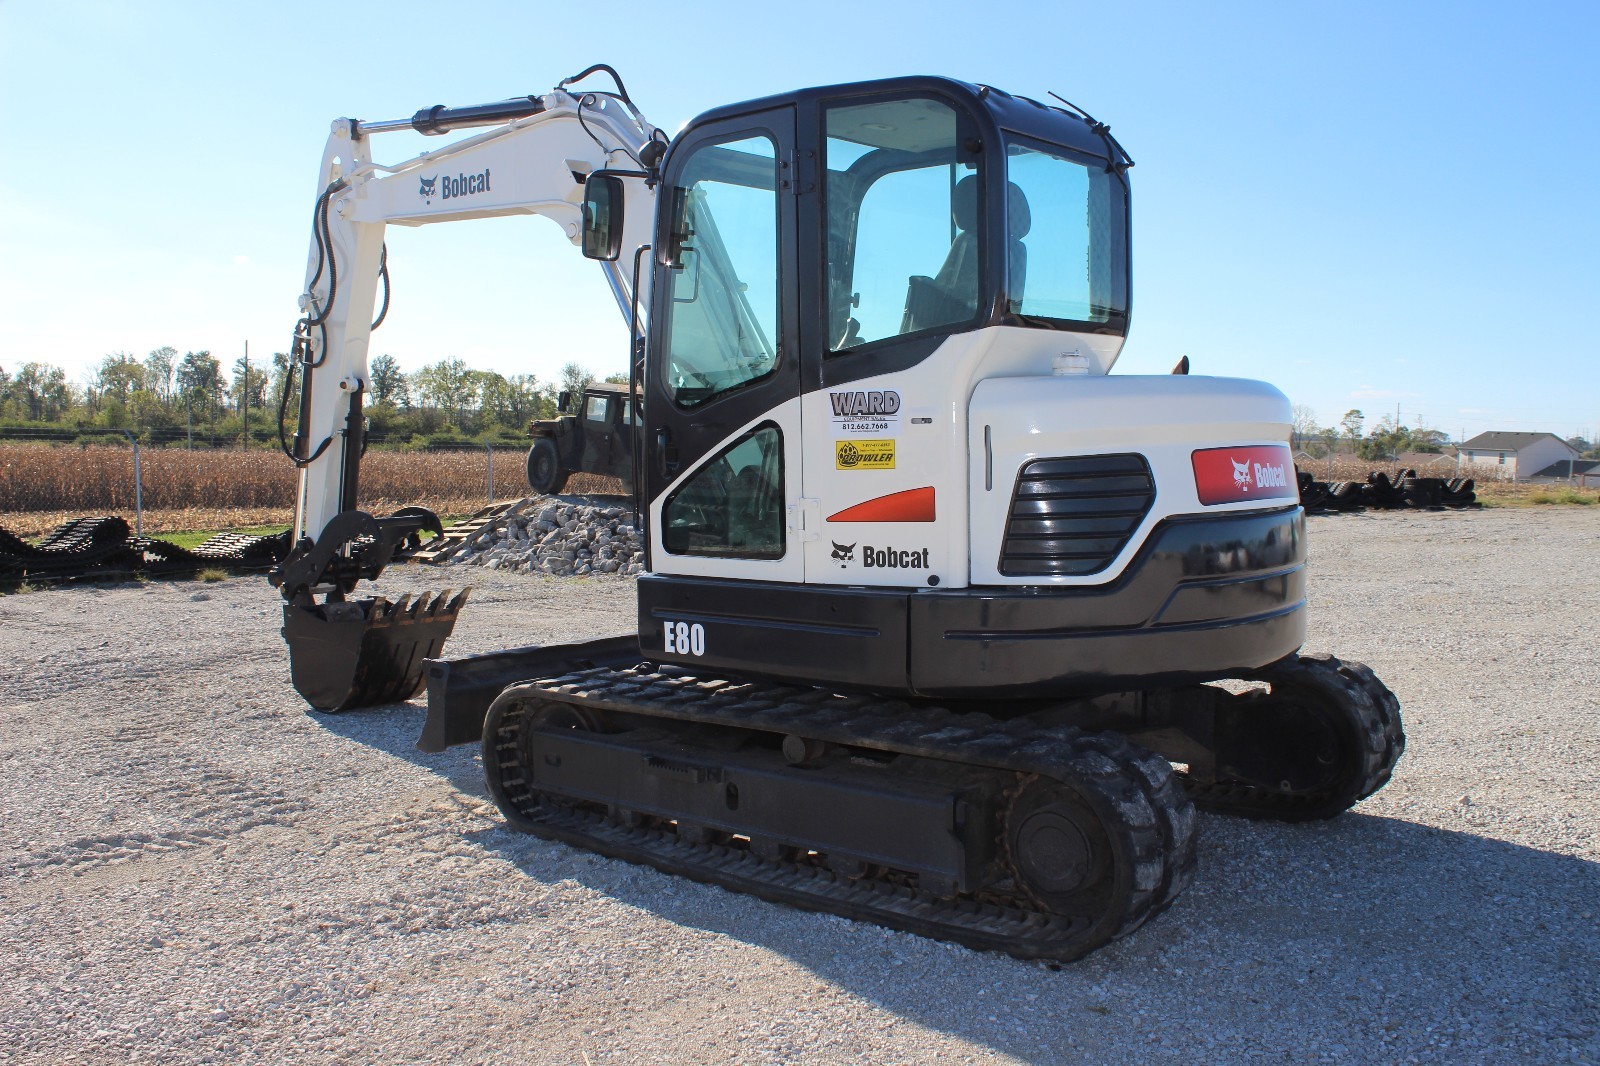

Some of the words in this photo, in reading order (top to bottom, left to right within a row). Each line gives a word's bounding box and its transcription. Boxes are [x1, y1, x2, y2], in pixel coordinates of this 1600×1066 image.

[442, 168, 490, 199] Bobcat
[830, 391, 900, 416] WARD
[842, 453, 893, 462] PROWLER
[1253, 462, 1287, 488] Bobcat
[862, 545, 930, 569] Bobcat
[663, 621, 705, 657] E80
